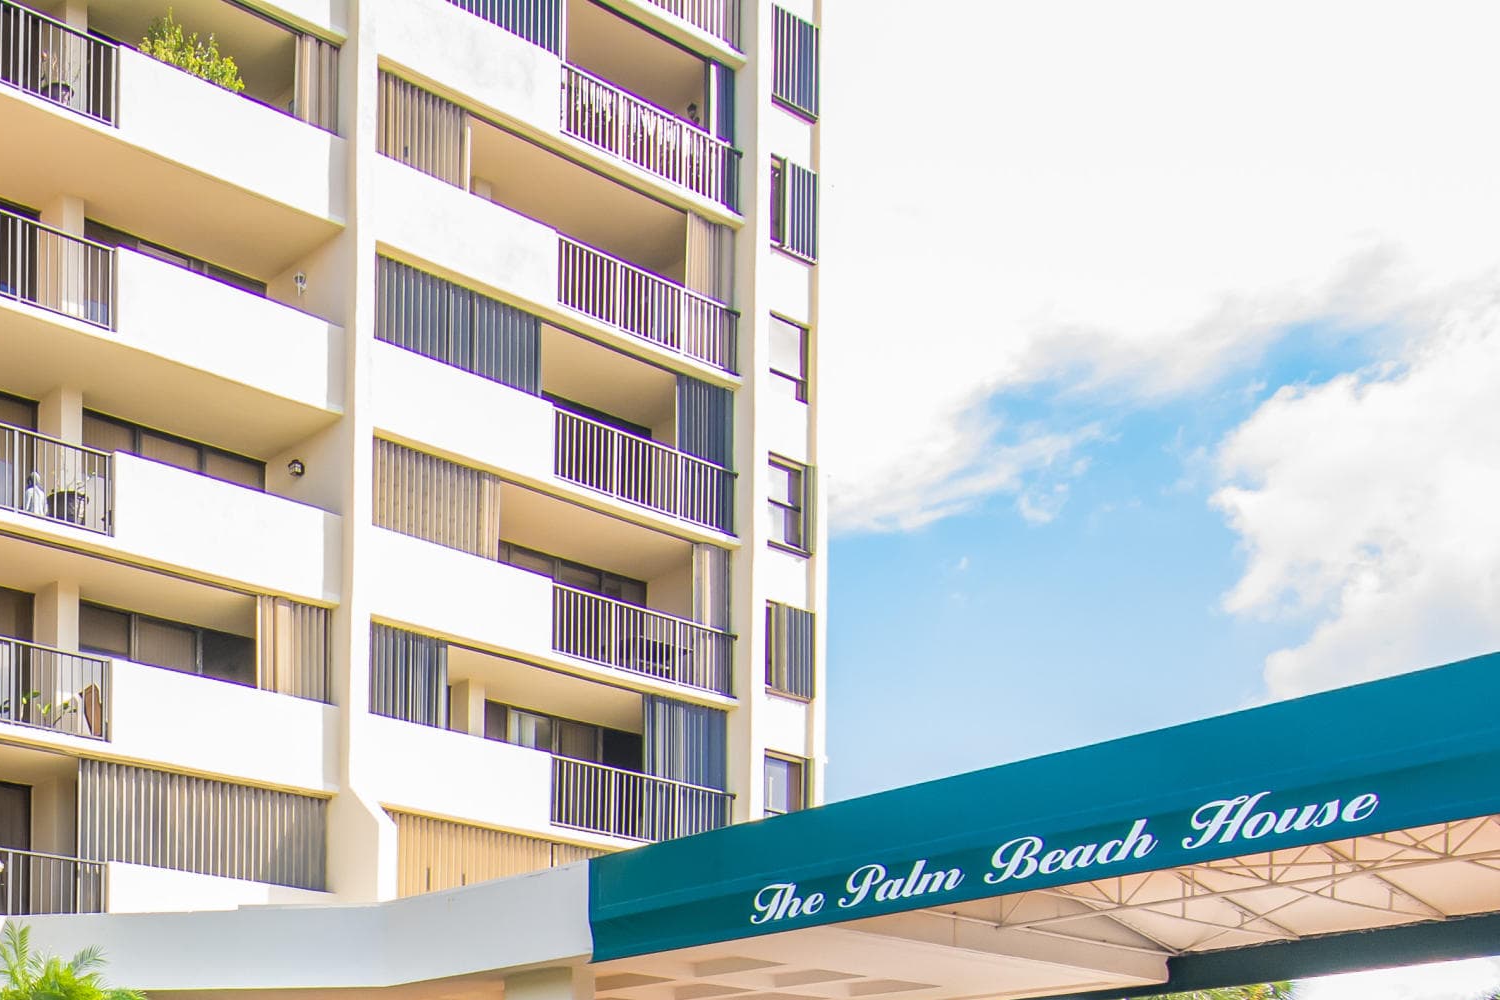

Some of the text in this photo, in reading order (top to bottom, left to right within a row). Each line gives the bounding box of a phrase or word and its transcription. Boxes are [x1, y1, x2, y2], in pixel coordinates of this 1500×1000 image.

[750, 791, 1380, 924] The Palm Beach House
